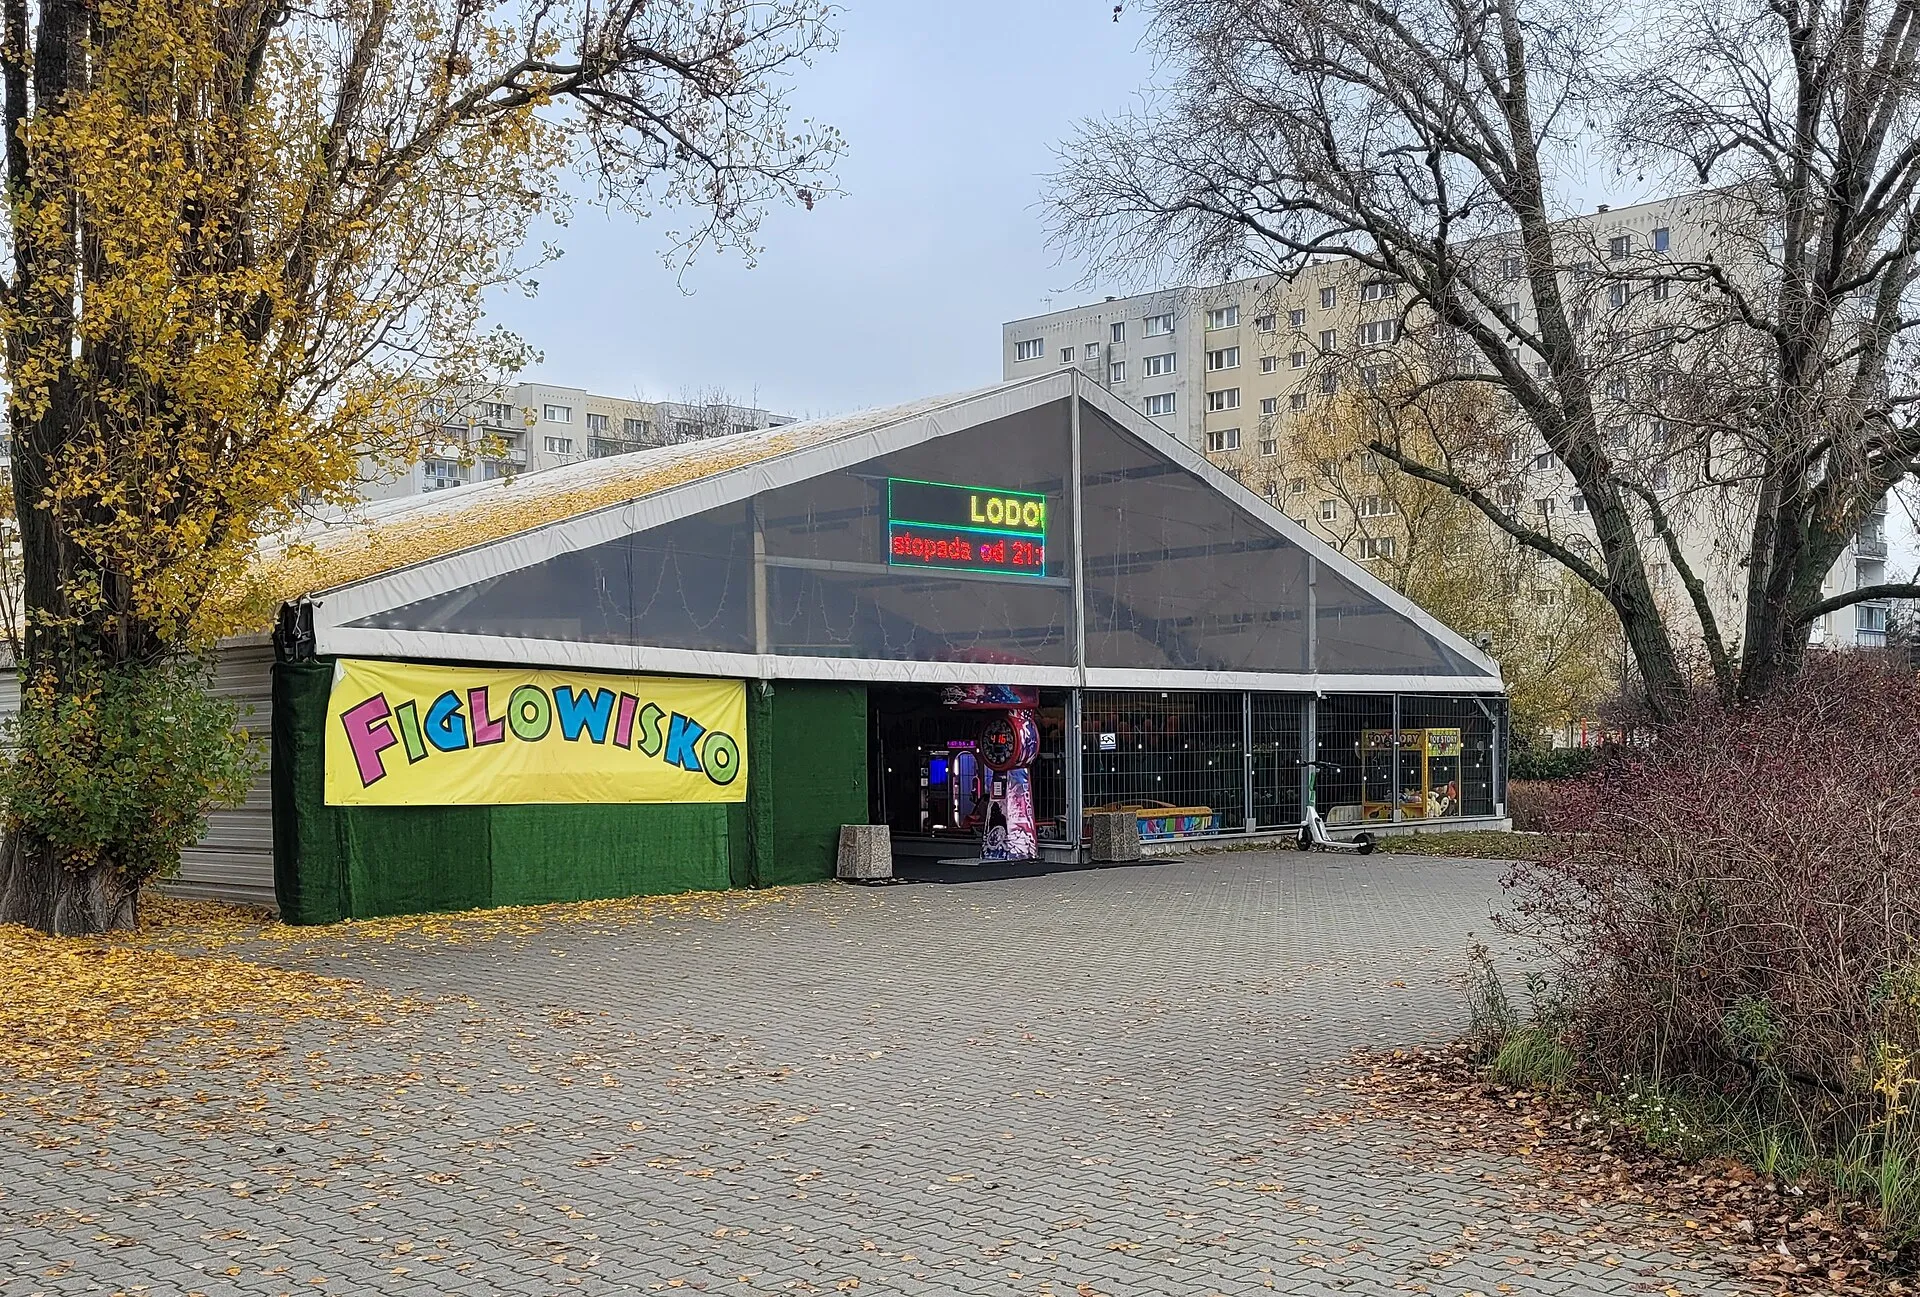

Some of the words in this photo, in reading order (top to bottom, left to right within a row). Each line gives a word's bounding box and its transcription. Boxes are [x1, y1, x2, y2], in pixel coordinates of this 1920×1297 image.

[980, 540, 1005, 563] od
[340, 685, 740, 788] FIGLOWISKO
[1389, 733, 1419, 744] SORY
